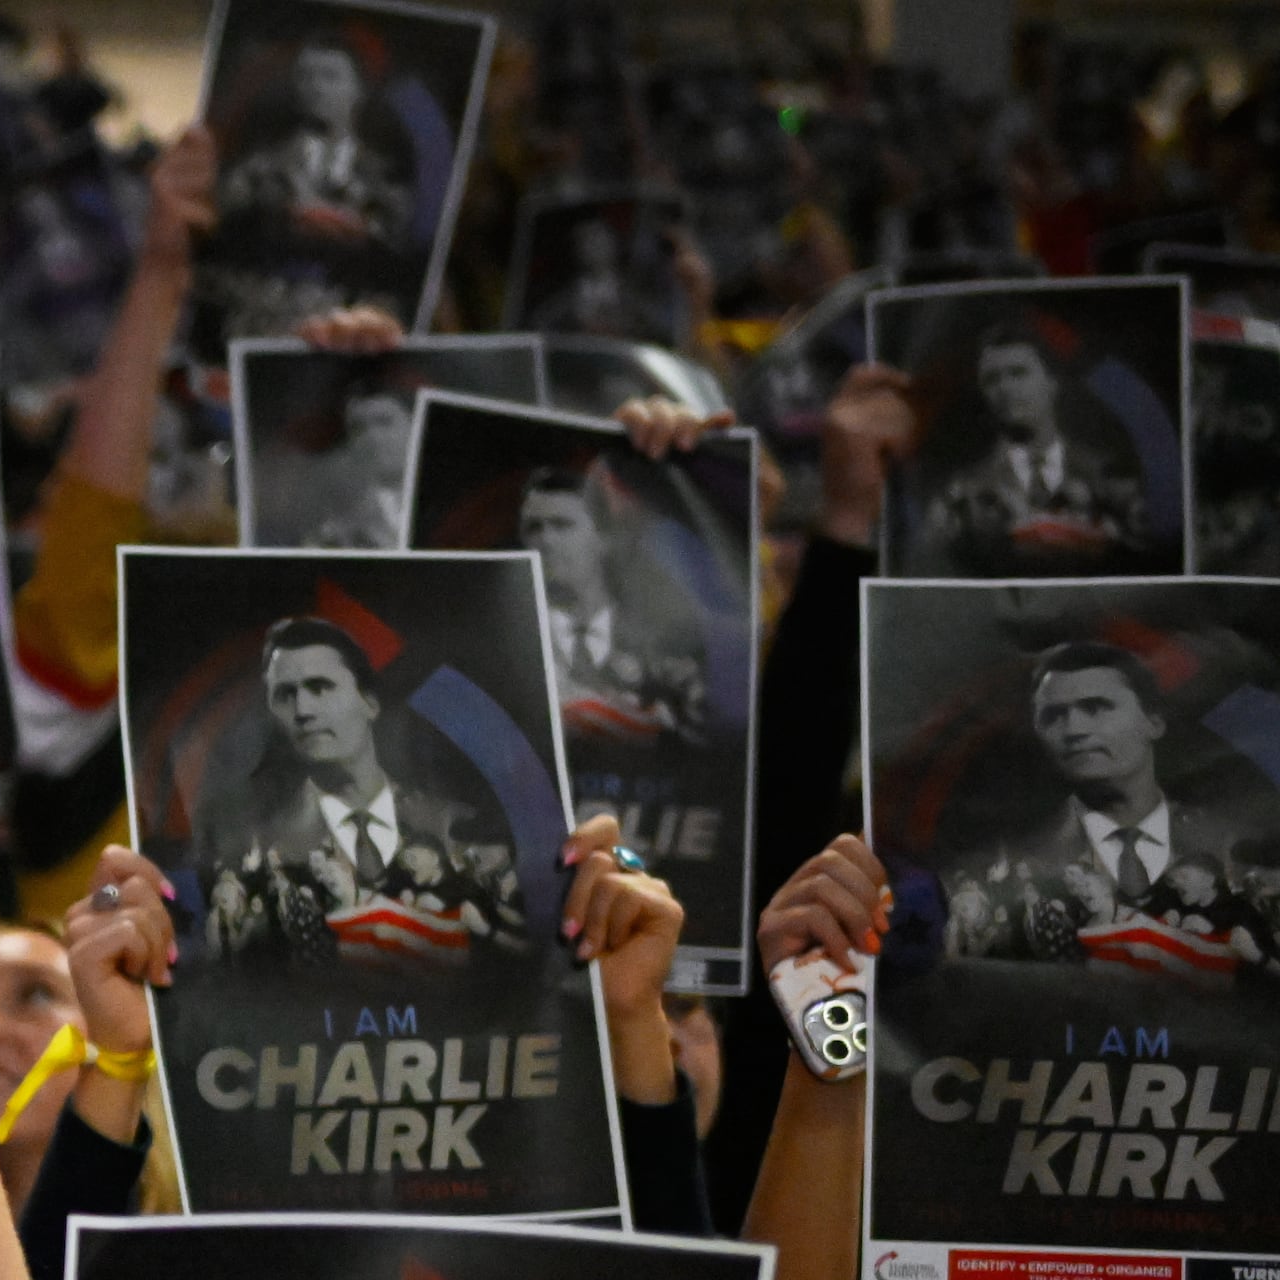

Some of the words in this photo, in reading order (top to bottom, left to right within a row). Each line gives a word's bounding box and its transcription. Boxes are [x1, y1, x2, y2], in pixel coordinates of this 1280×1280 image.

[323, 1007, 335, 1039] I
[355, 1004, 418, 1037] AM
[1064, 1022, 1074, 1055] I
[1098, 1026, 1170, 1059] AM
[195, 1032, 563, 1111] CHARLIE
[289, 1103, 489, 1176] KIRK
[1000, 1129, 1239, 1201] KIRK
[957, 1259, 1017, 1273] IDENTIFY
[1027, 1261, 1095, 1276] EMPOWER
[1105, 1264, 1173, 1279] ORGANIZE
